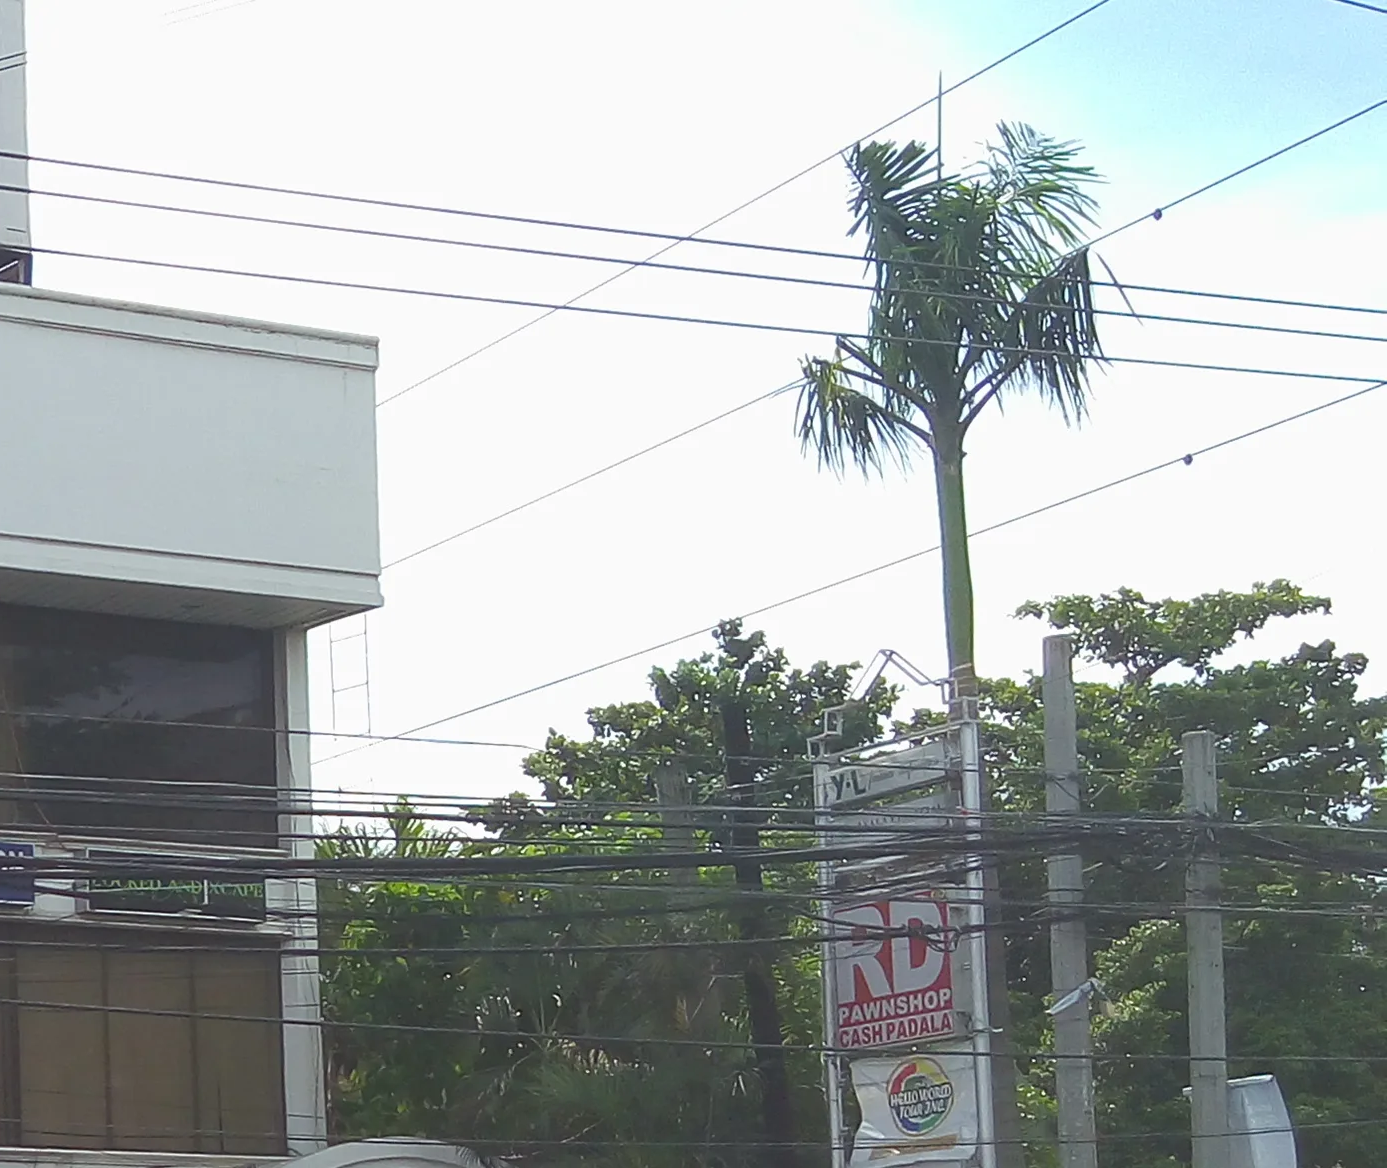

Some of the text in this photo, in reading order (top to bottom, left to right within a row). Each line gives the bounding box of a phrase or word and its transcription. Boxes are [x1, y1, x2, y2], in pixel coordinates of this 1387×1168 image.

[833, 901, 950, 1004] RD
[838, 988, 951, 1026] PAWNSHOP
[839, 1011, 951, 1049] CASH PADALA
